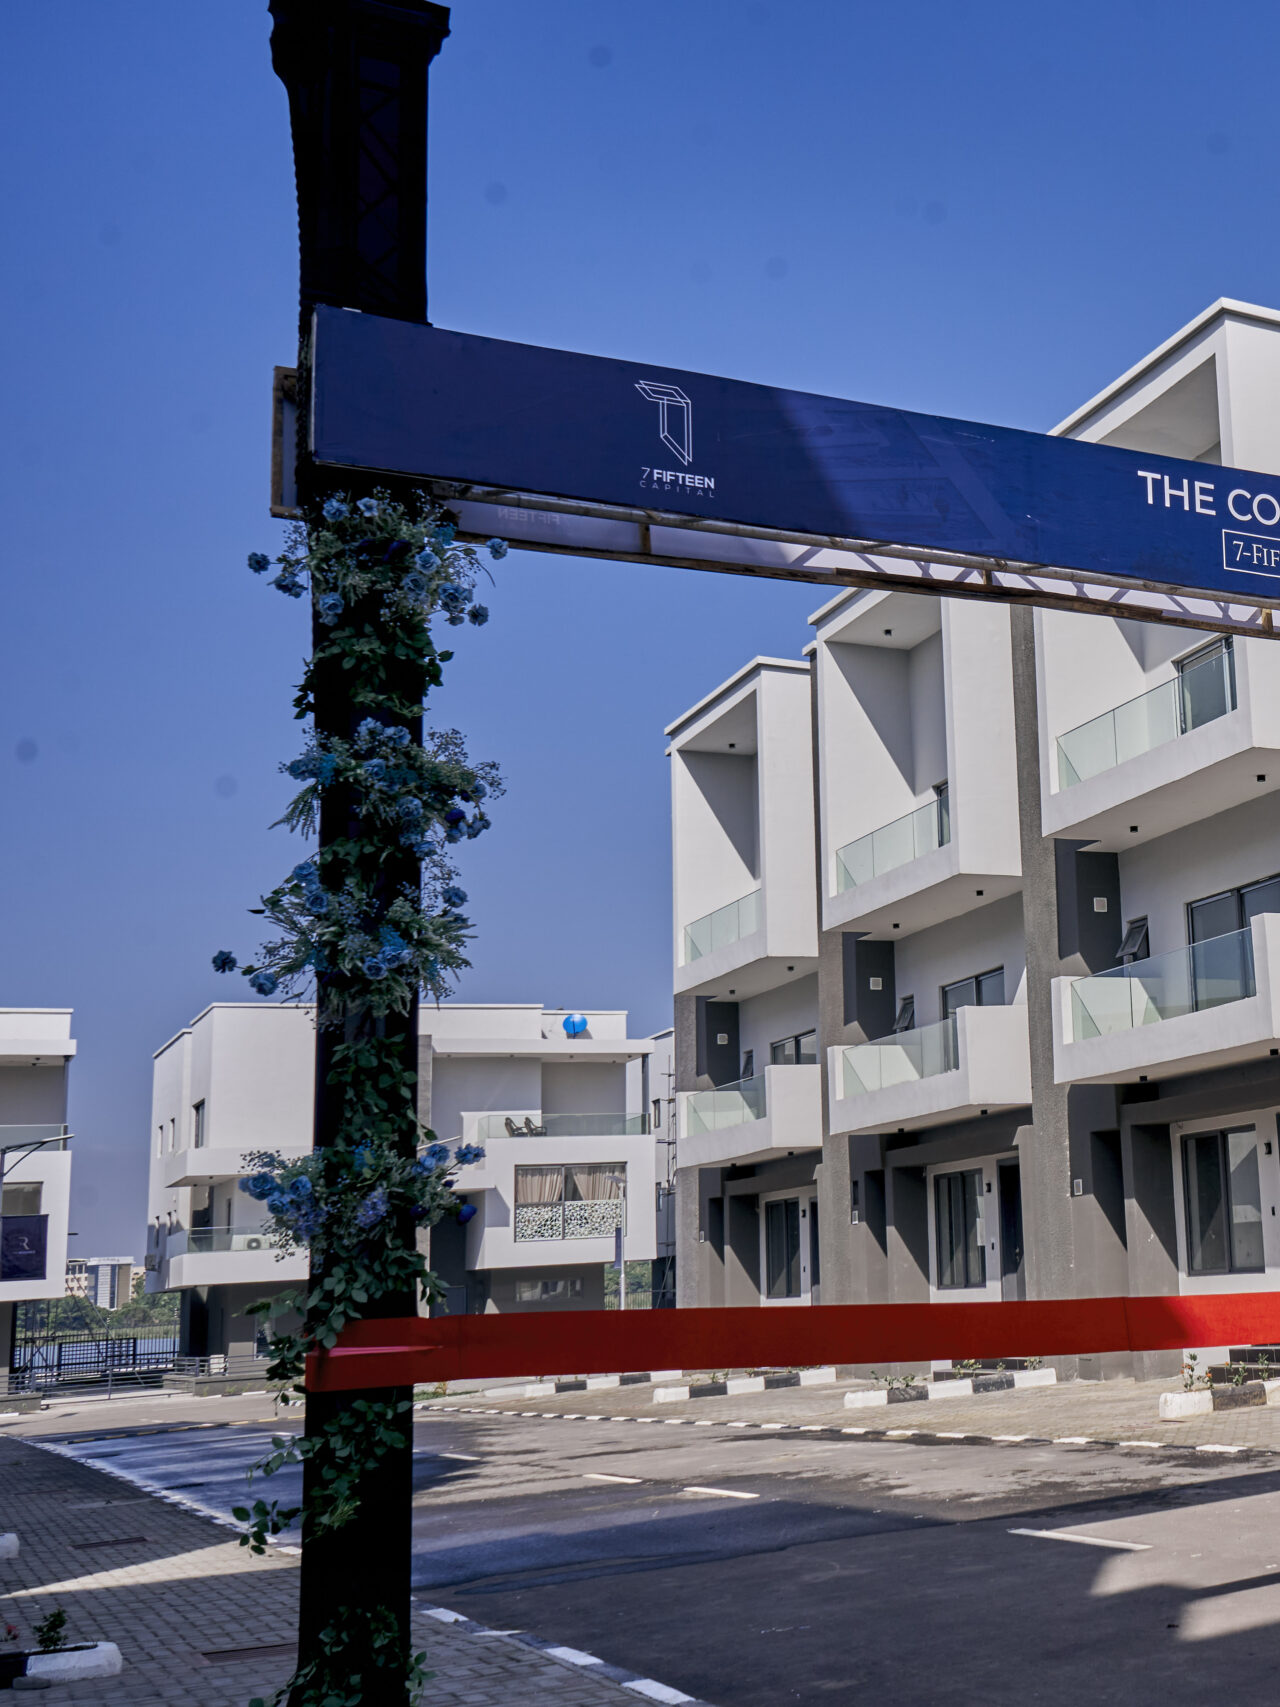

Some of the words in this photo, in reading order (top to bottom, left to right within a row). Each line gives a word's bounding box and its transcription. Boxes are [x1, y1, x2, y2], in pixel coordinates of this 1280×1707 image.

[640, 480, 715, 498] CAPITAL
[641, 466, 651, 479] 7
[653, 469, 715, 489] FIFTEEN
[1137, 470, 1217, 516] THE
